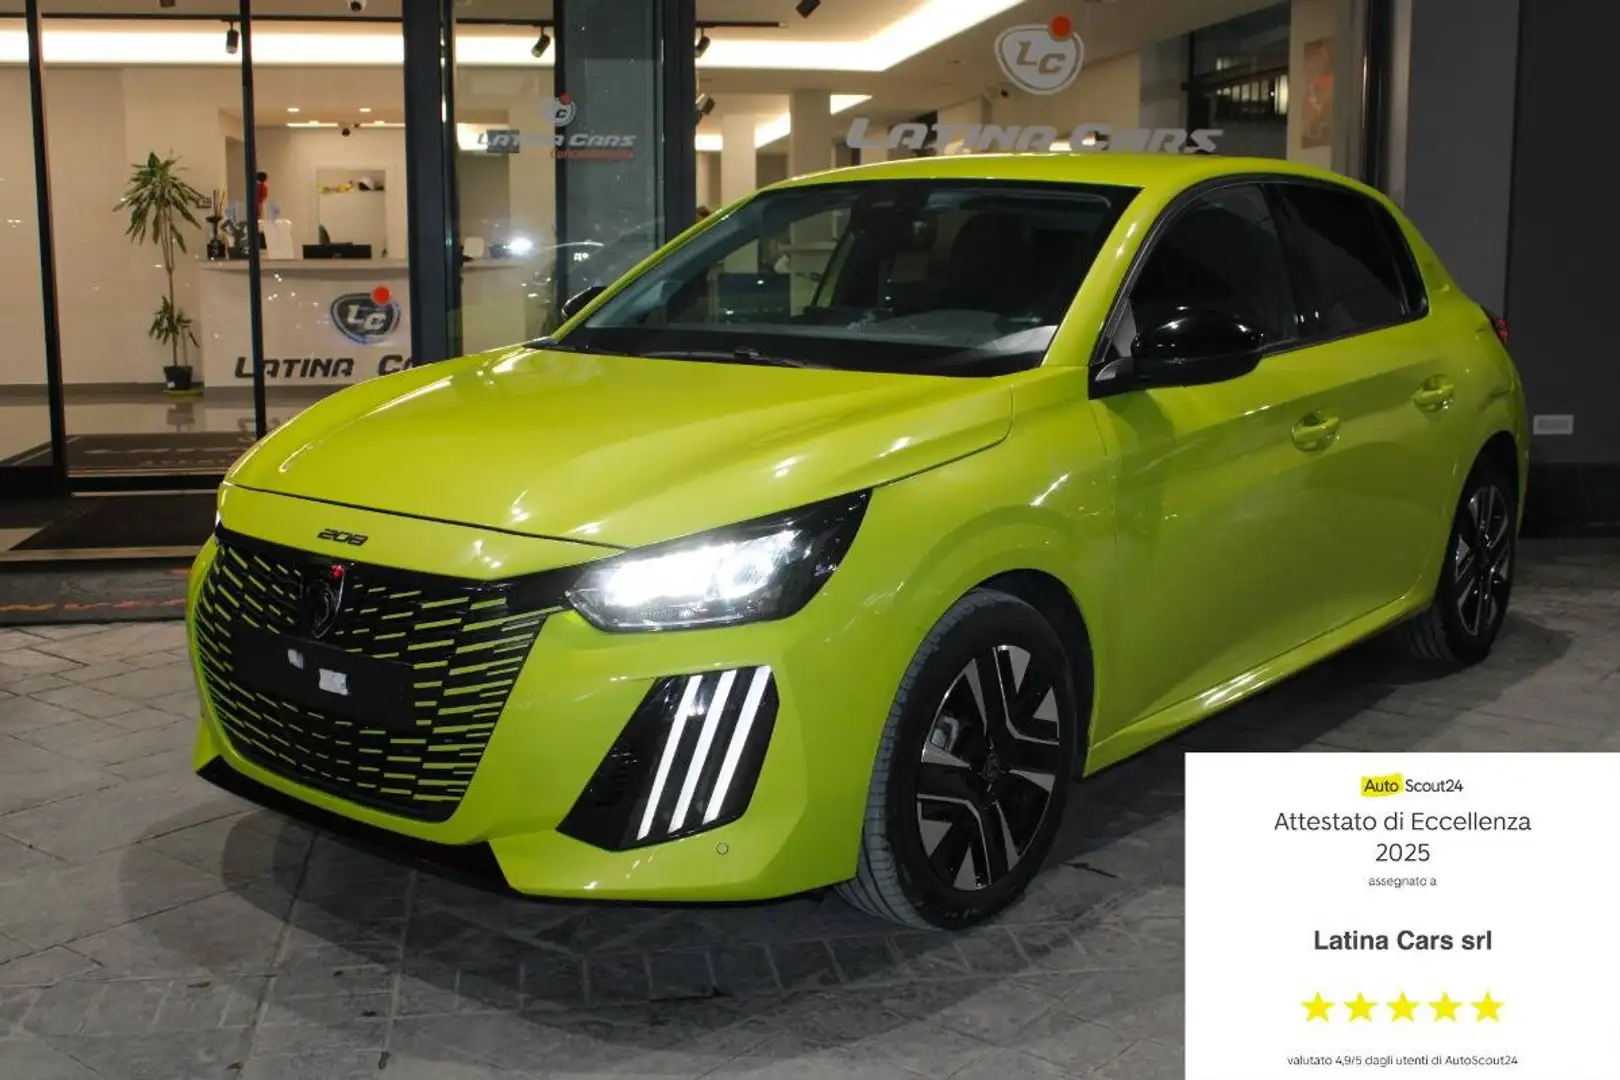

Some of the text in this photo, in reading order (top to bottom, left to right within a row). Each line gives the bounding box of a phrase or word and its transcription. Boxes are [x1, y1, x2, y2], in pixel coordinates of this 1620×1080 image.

[1016, 40, 1066, 76] LC
[569, 133, 637, 147] CARS
[846, 118, 1224, 154] LATINA CARS
[347, 304, 387, 331] LC
[234, 357, 354, 379] LATINA
[317, 528, 369, 547] 208
